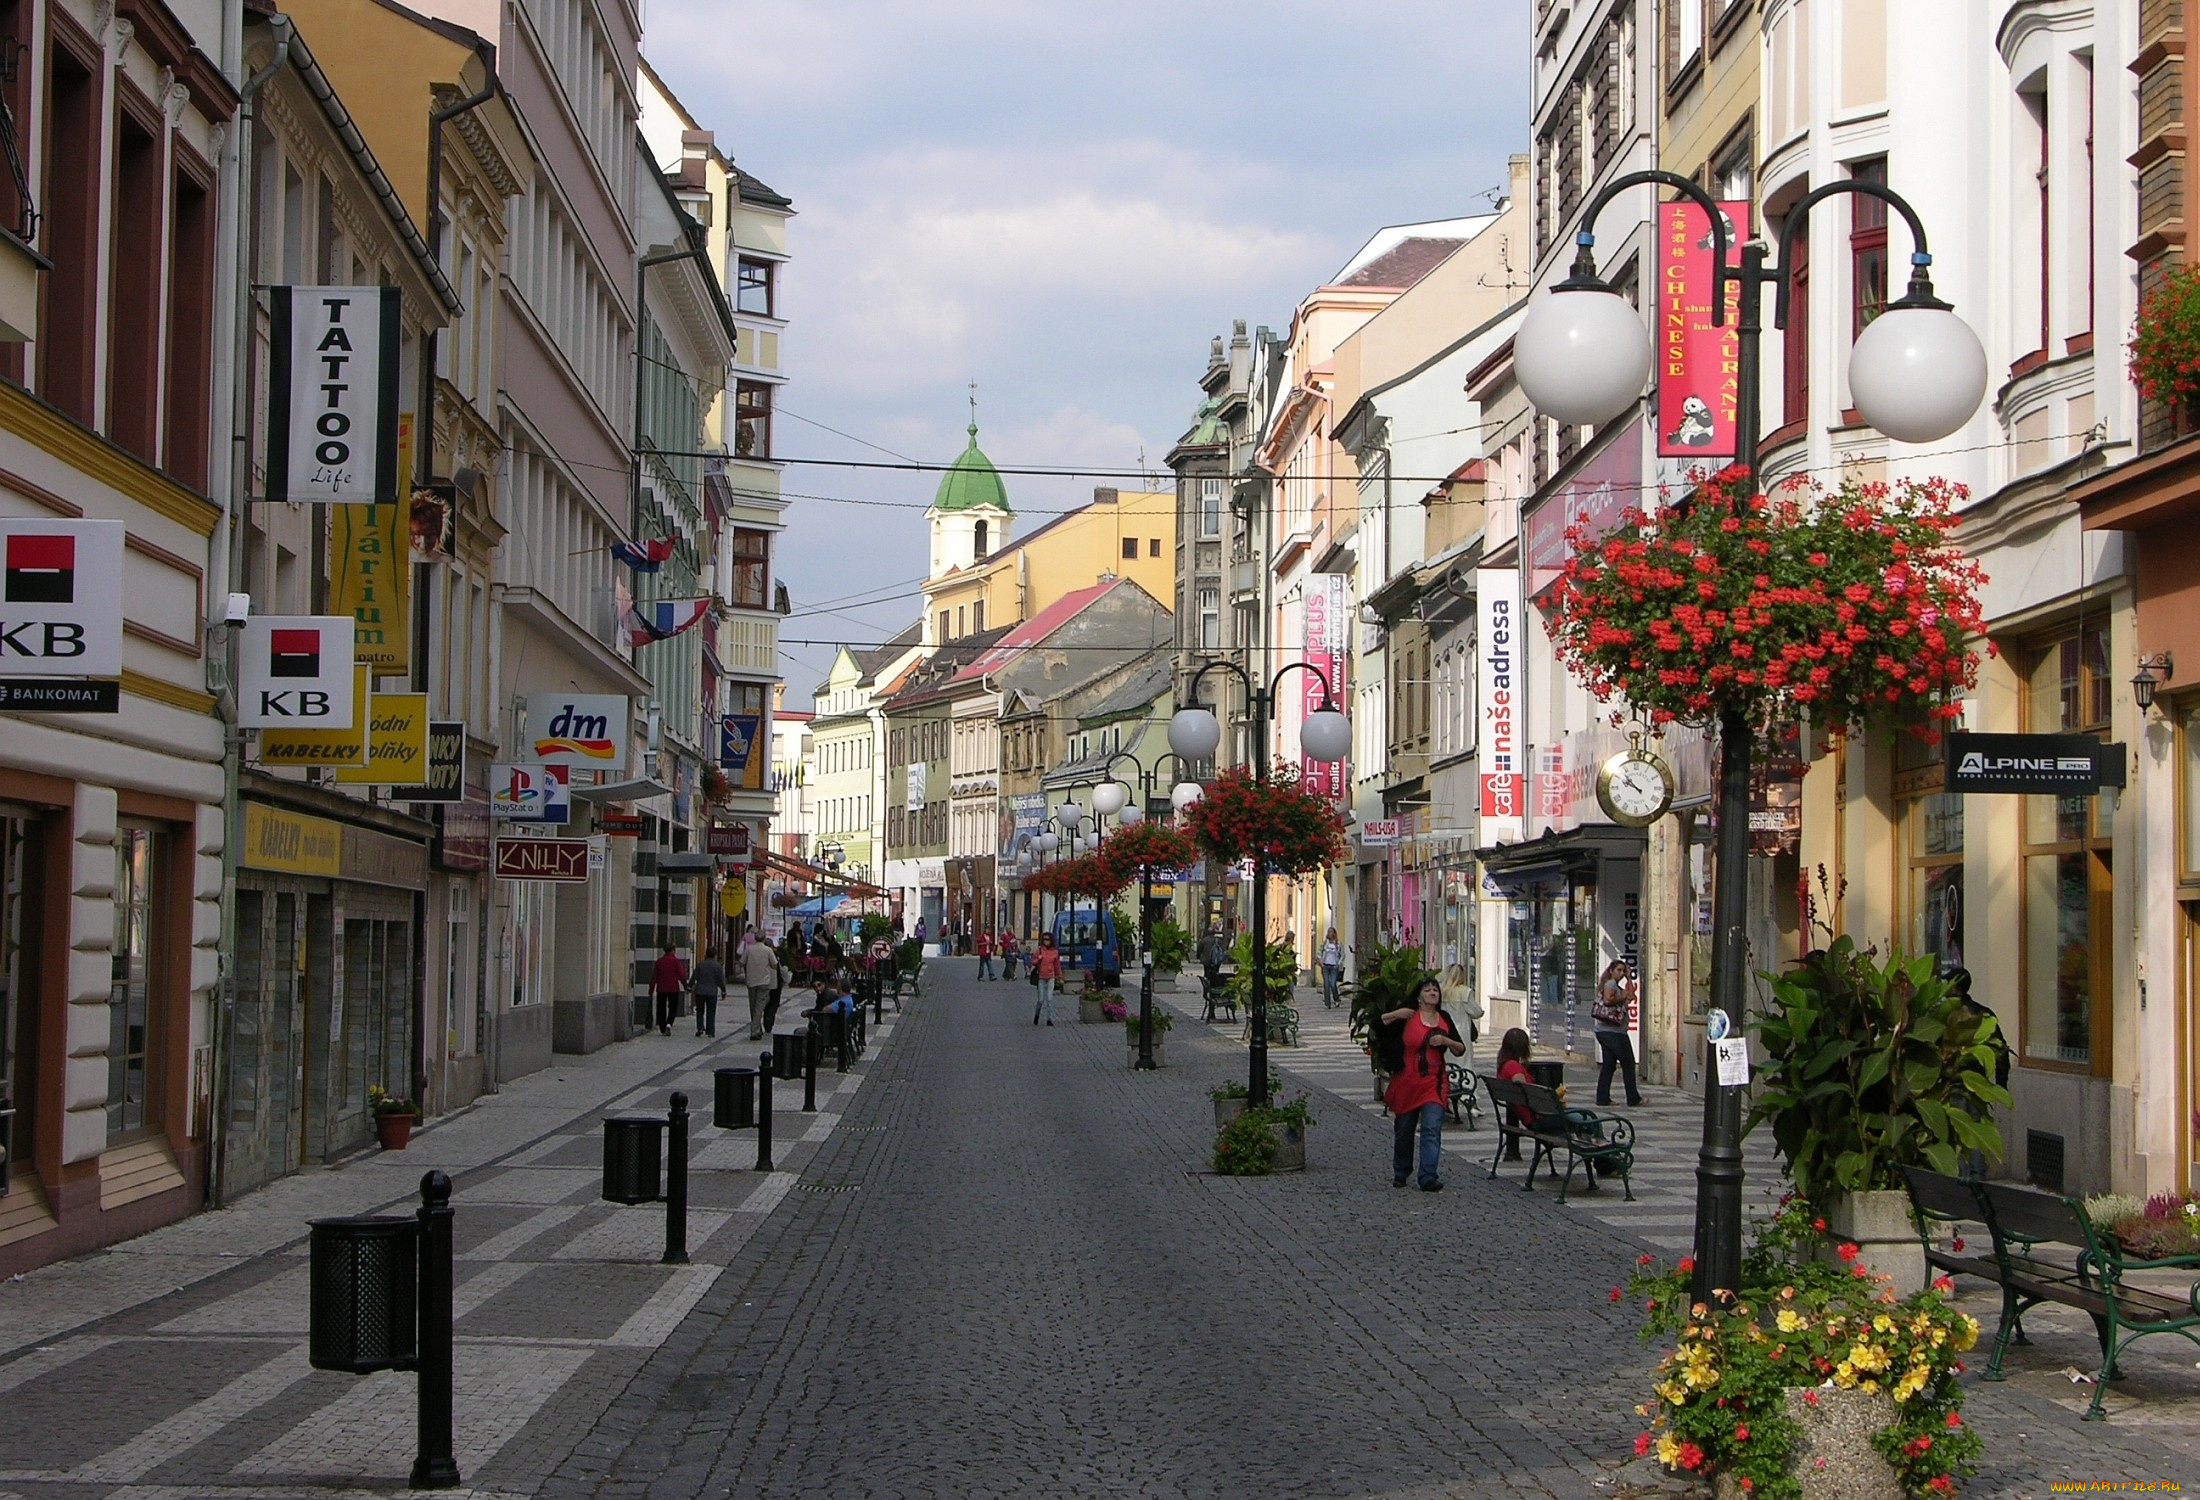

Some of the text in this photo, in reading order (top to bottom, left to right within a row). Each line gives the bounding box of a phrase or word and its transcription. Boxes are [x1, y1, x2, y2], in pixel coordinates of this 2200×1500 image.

[1666, 265, 1686, 376] CHINESE
[1684, 304, 1713, 313] shan
[1720, 265, 1740, 422] ESTAURANT
[316, 298, 353, 466] TATTOO
[310, 467, 352, 491] Life
[354, 504, 385, 644] lárium
[1306, 593, 1325, 650] PLUS
[1329, 576, 1342, 693] www.preventplus.cz
[0, 622, 87, 657] KB
[357, 651, 395, 663] patro
[1487, 599, 1510, 753] našeadresa
[13, 688, 101, 702] BANKOMAT
[259, 691, 330, 716] KB
[370, 714, 413, 732] ódní
[549, 704, 607, 739] dm
[266, 744, 360, 759] KABELKY
[370, 741, 418, 764] plňky
[1957, 752, 2055, 773] ALPINE
[1364, 822, 1396, 836] NAILS-USA
[499, 843, 585, 876] KNIHY
